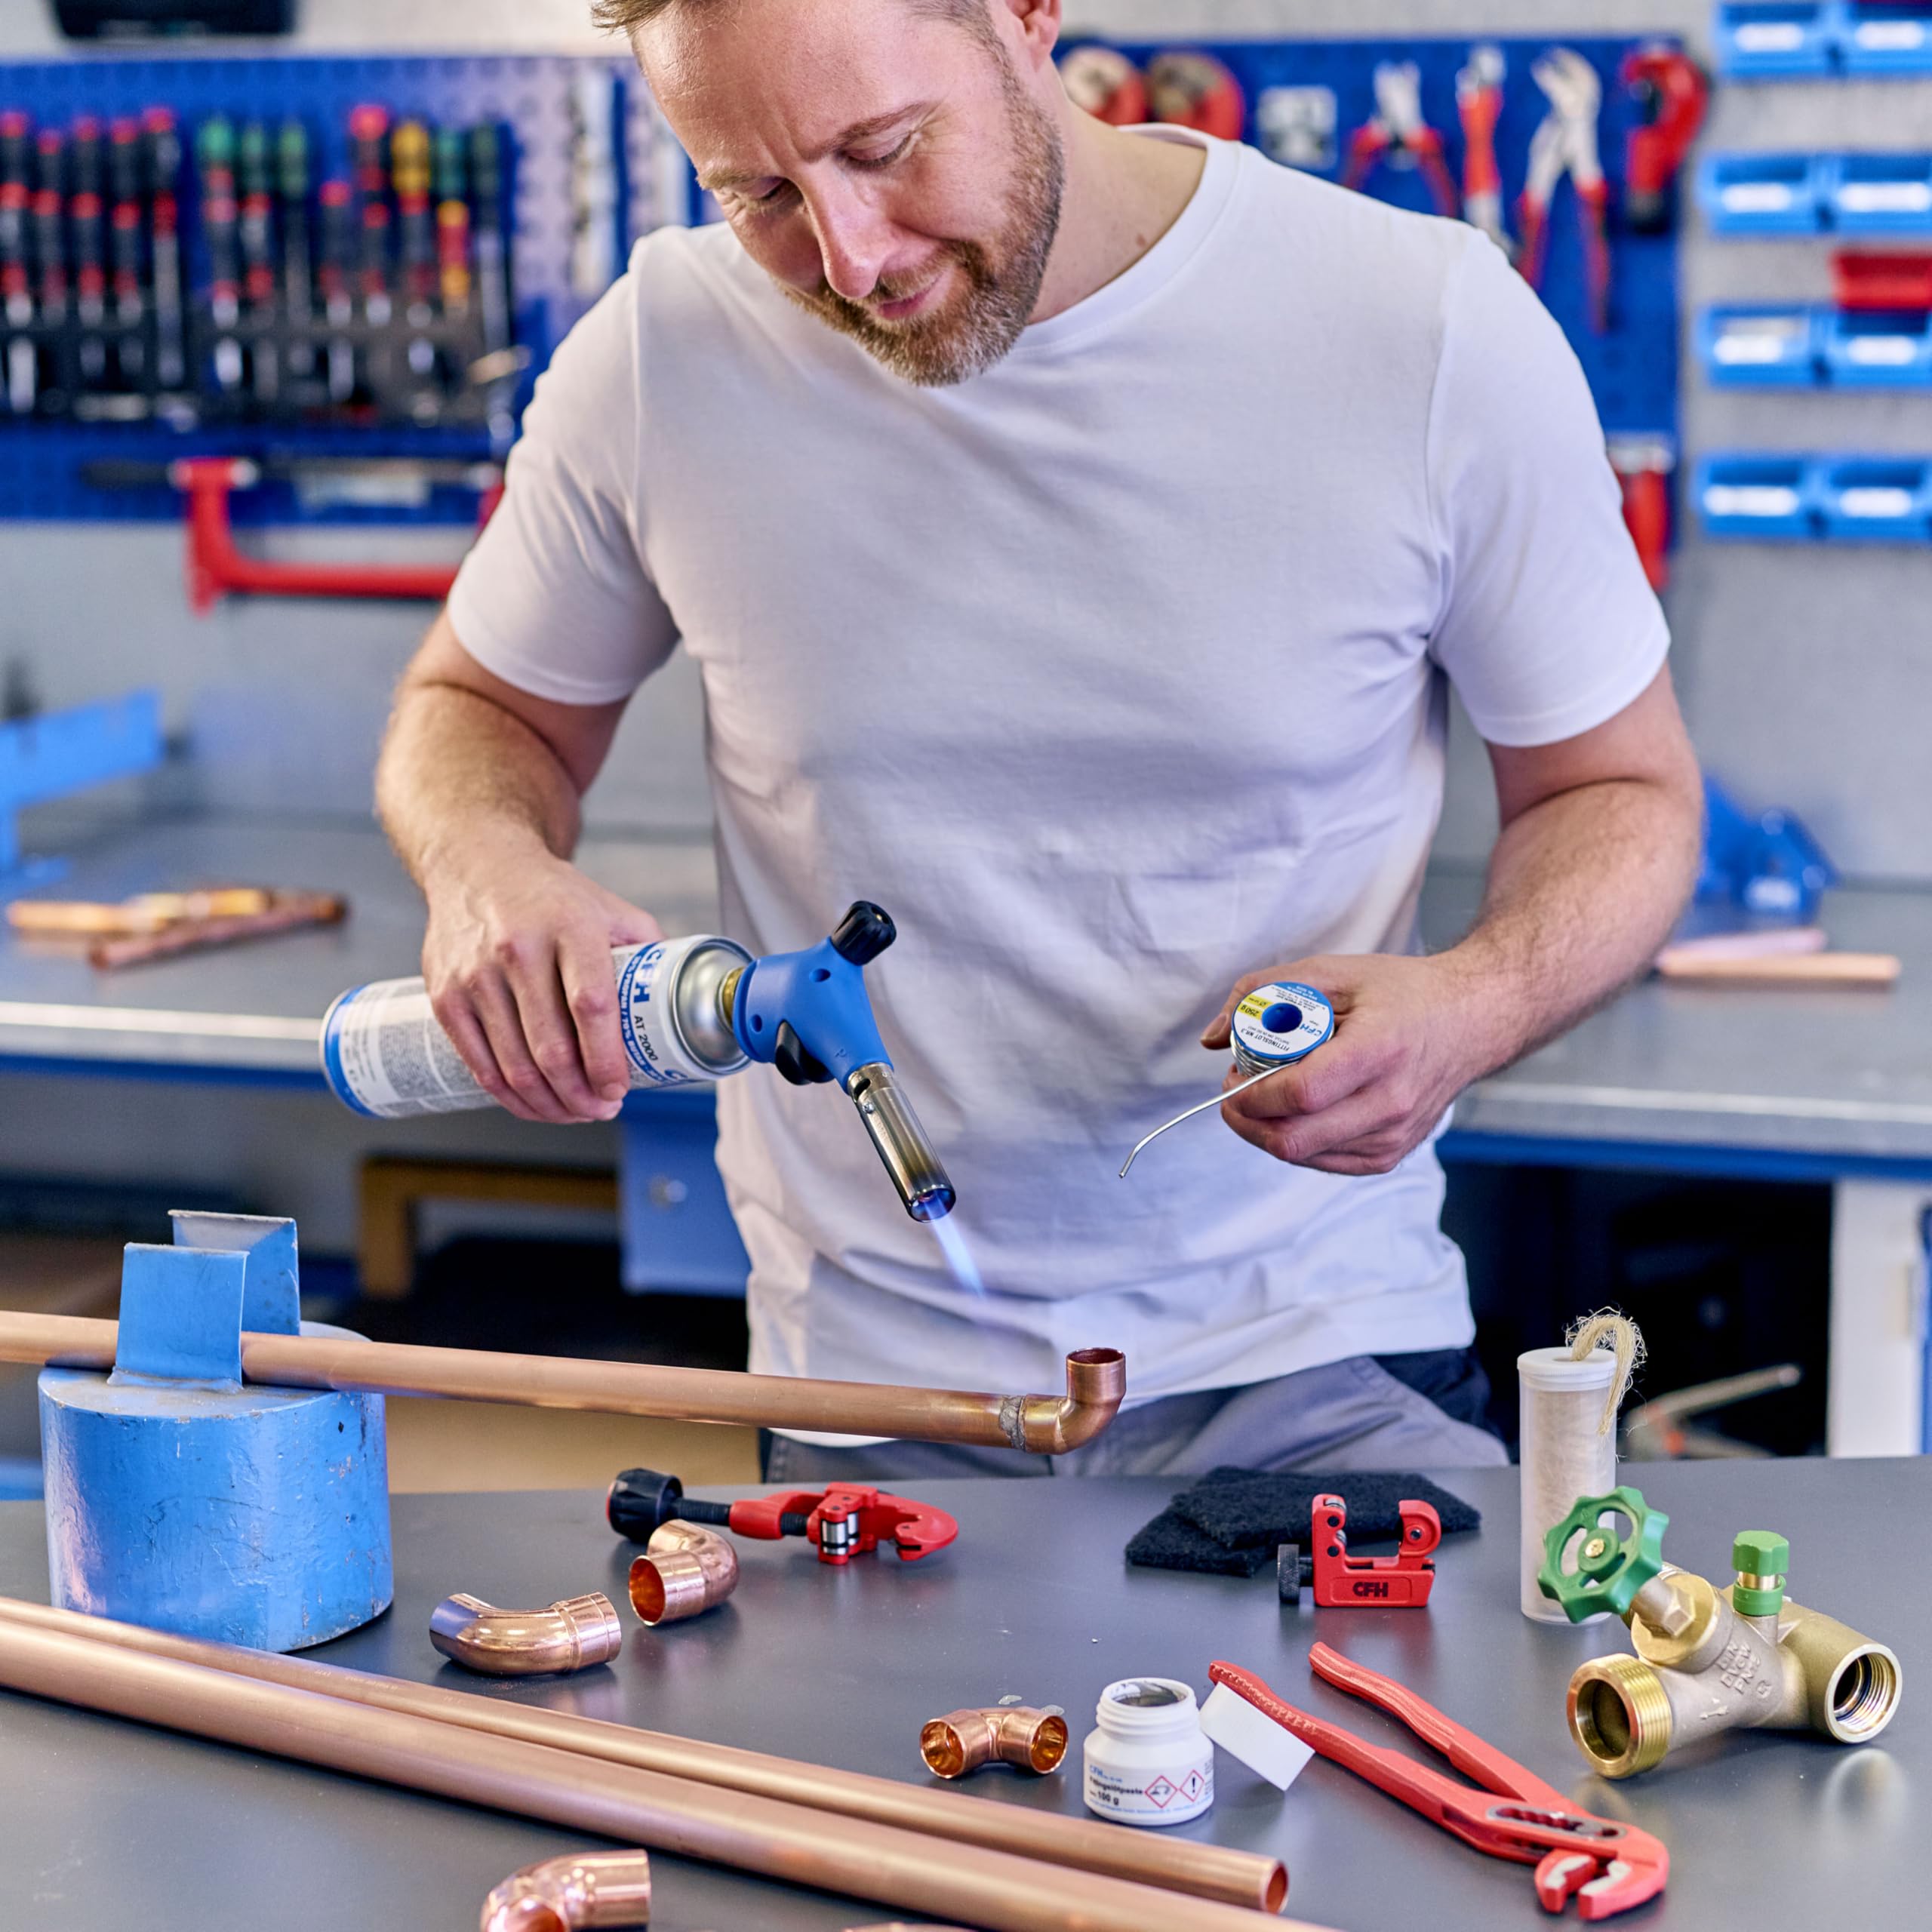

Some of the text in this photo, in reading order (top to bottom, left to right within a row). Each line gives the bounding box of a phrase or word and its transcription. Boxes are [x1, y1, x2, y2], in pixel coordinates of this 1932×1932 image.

[634, 948, 666, 1003] CFH
[1244, 1007, 1260, 1017] 250
[622, 1018, 632, 1039] 70%
[635, 1016, 645, 1030] AT
[1300, 1023, 1323, 1037] CFH
[639, 1035, 659, 1061] 2000
[1254, 1033, 1291, 1052] FITTINGSLOT
[1352, 1581, 1389, 1598] CFH
